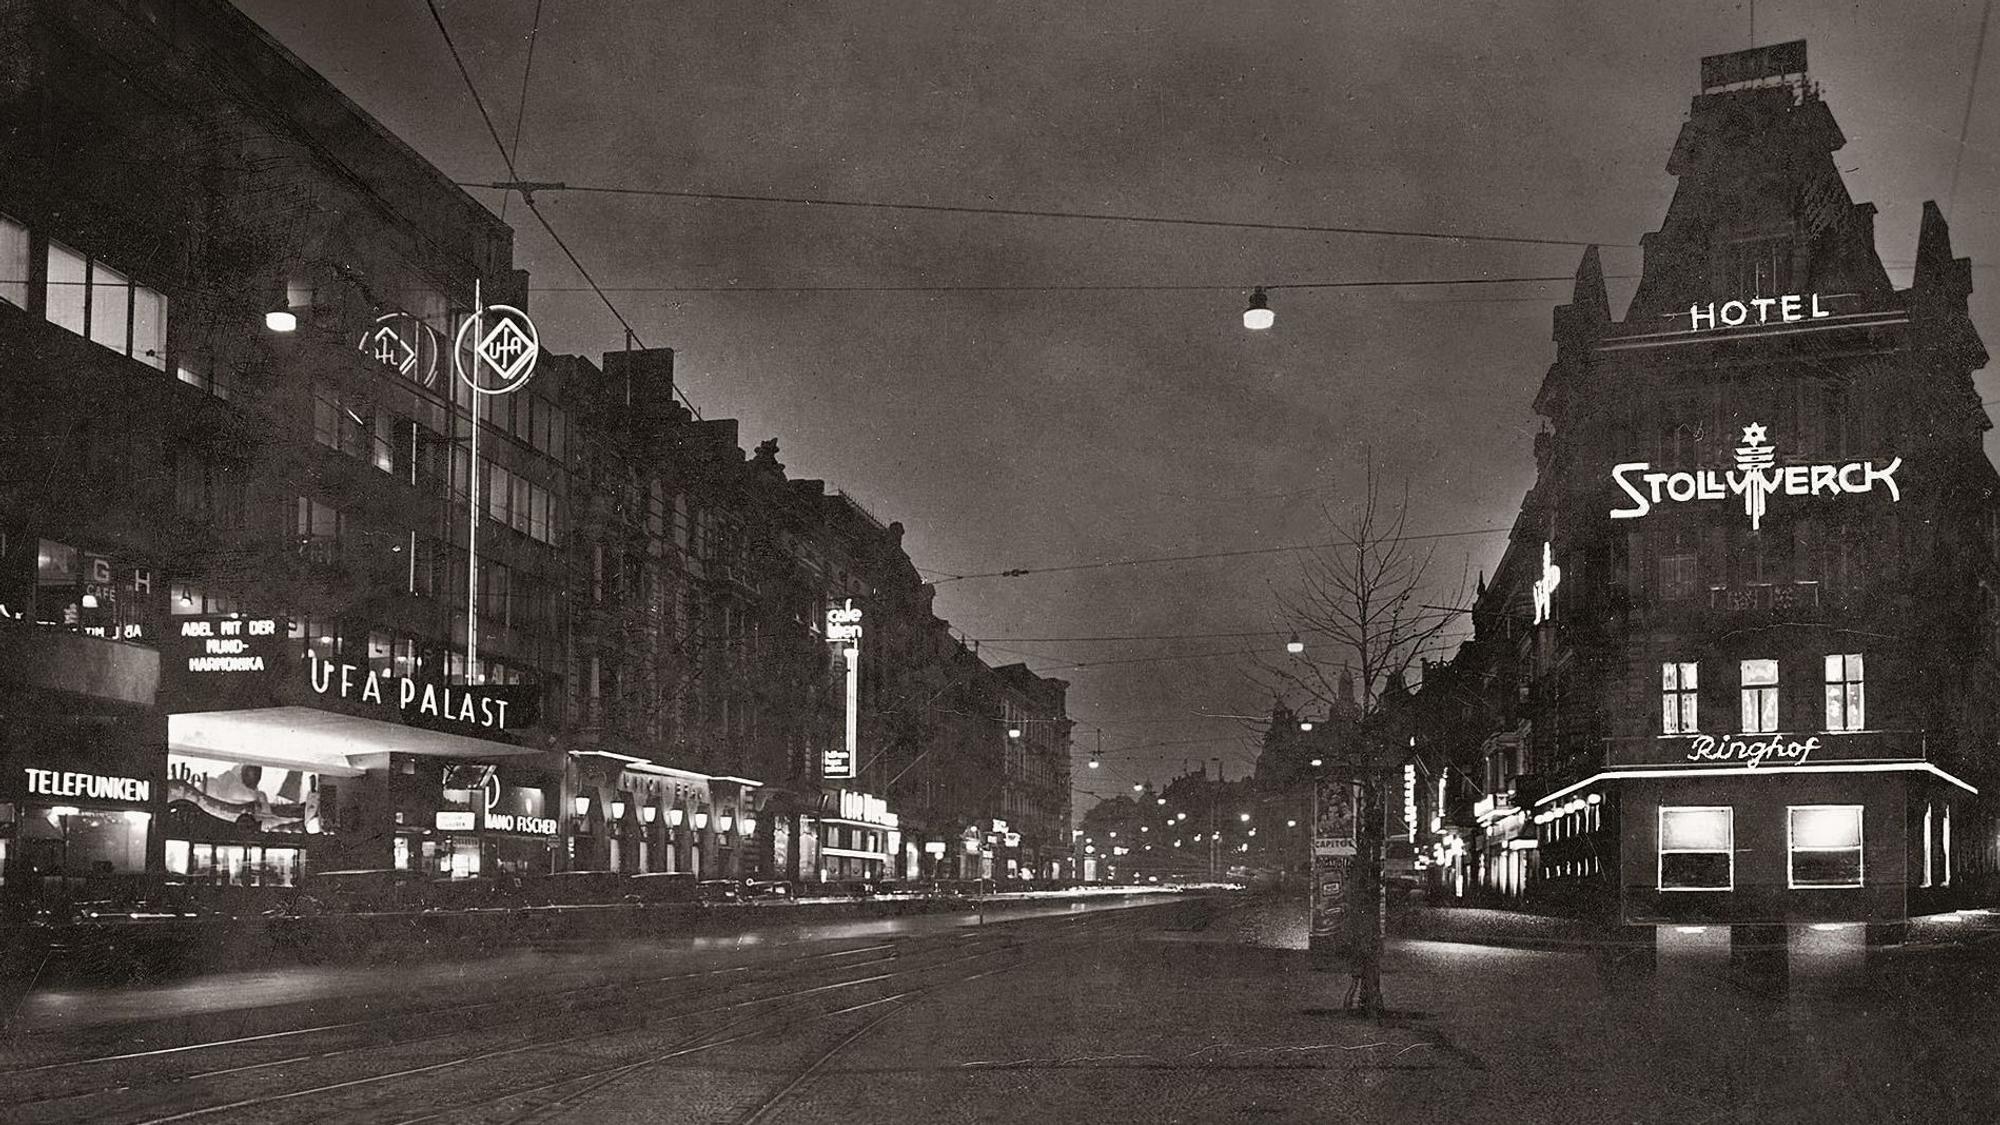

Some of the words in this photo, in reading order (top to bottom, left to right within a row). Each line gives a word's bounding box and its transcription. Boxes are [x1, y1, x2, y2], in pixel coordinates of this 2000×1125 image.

[1690, 293, 1829, 332] HOTEL
[181, 621, 215, 637] ABEL
[220, 620, 242, 636] MIT
[248, 619, 276, 636] DER
[308, 648, 382, 704] UFA
[400, 677, 509, 729] PALAST
[1687, 734, 1822, 768] Ringhof
[25, 768, 150, 801] TELEFUNKEN
[517, 814, 558, 834] FISCHER
